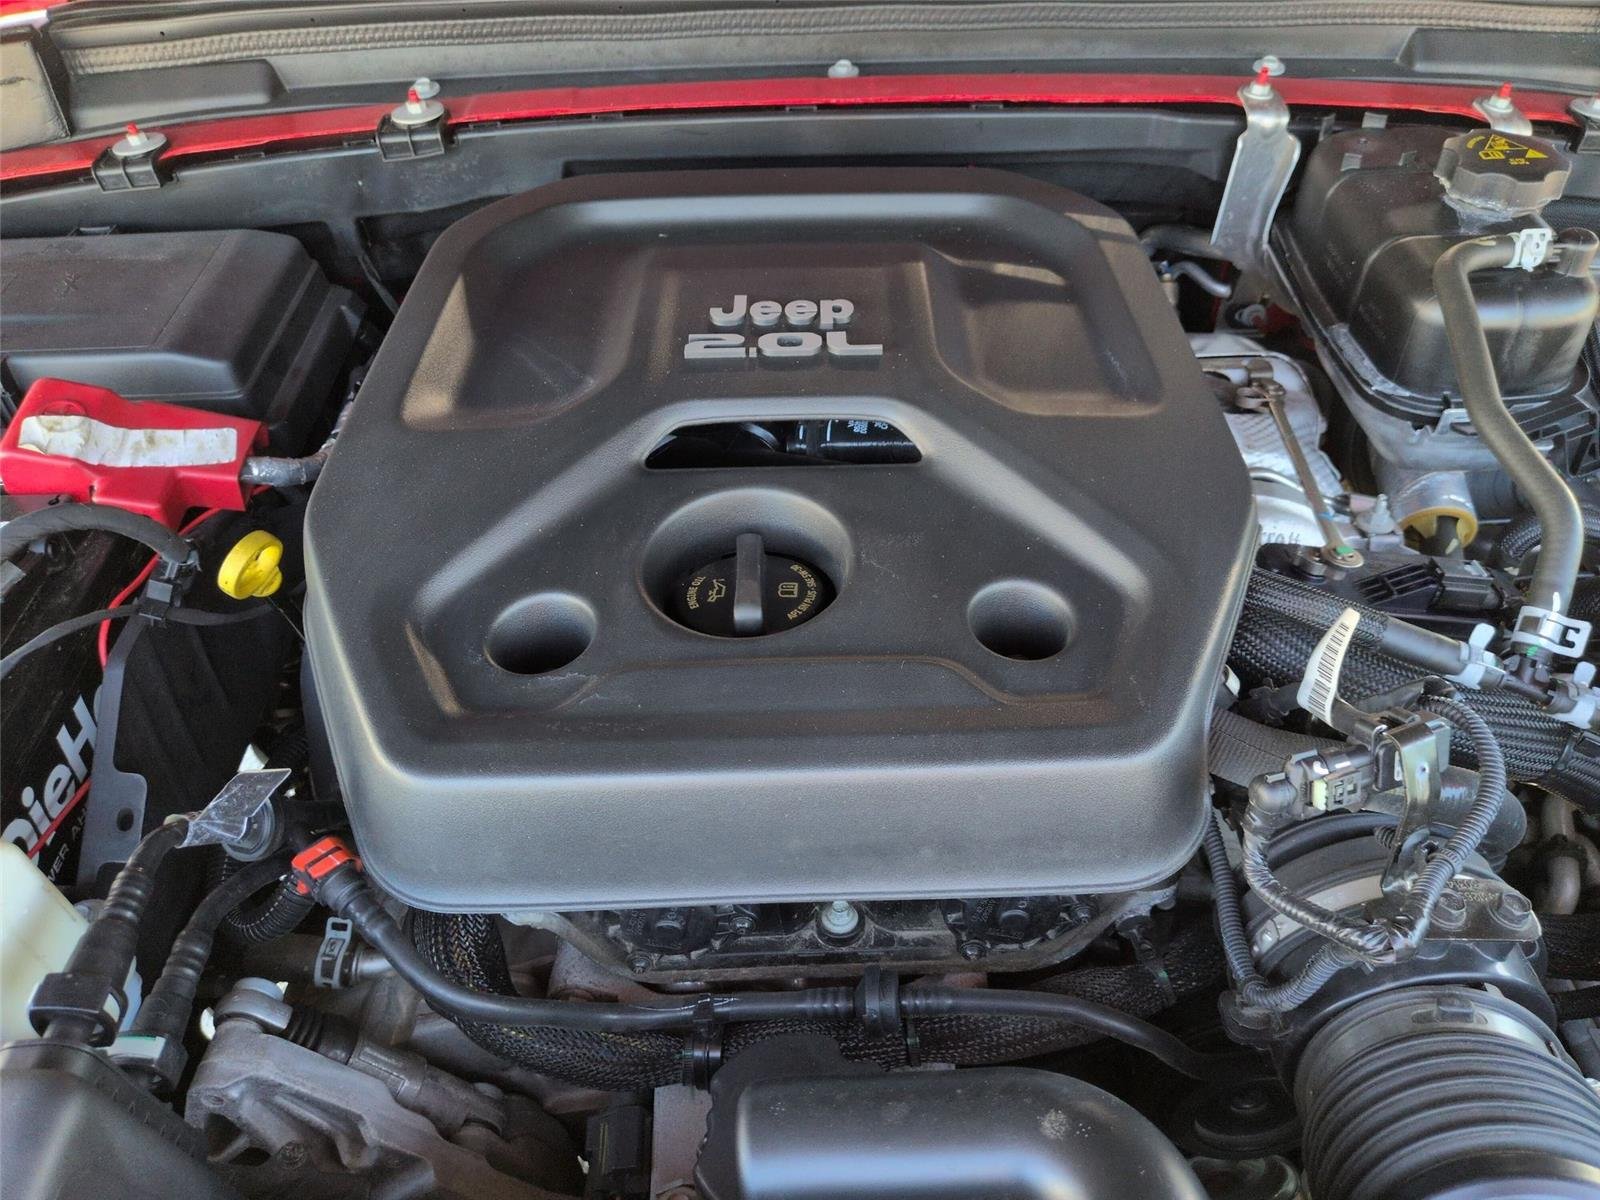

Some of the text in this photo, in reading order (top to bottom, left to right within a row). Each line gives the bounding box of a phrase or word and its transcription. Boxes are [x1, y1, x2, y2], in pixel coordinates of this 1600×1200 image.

[709, 294, 855, 330] Jeep
[683, 330, 884, 359] 2.0L
[686, 576, 707, 610] ENGINE OIL
